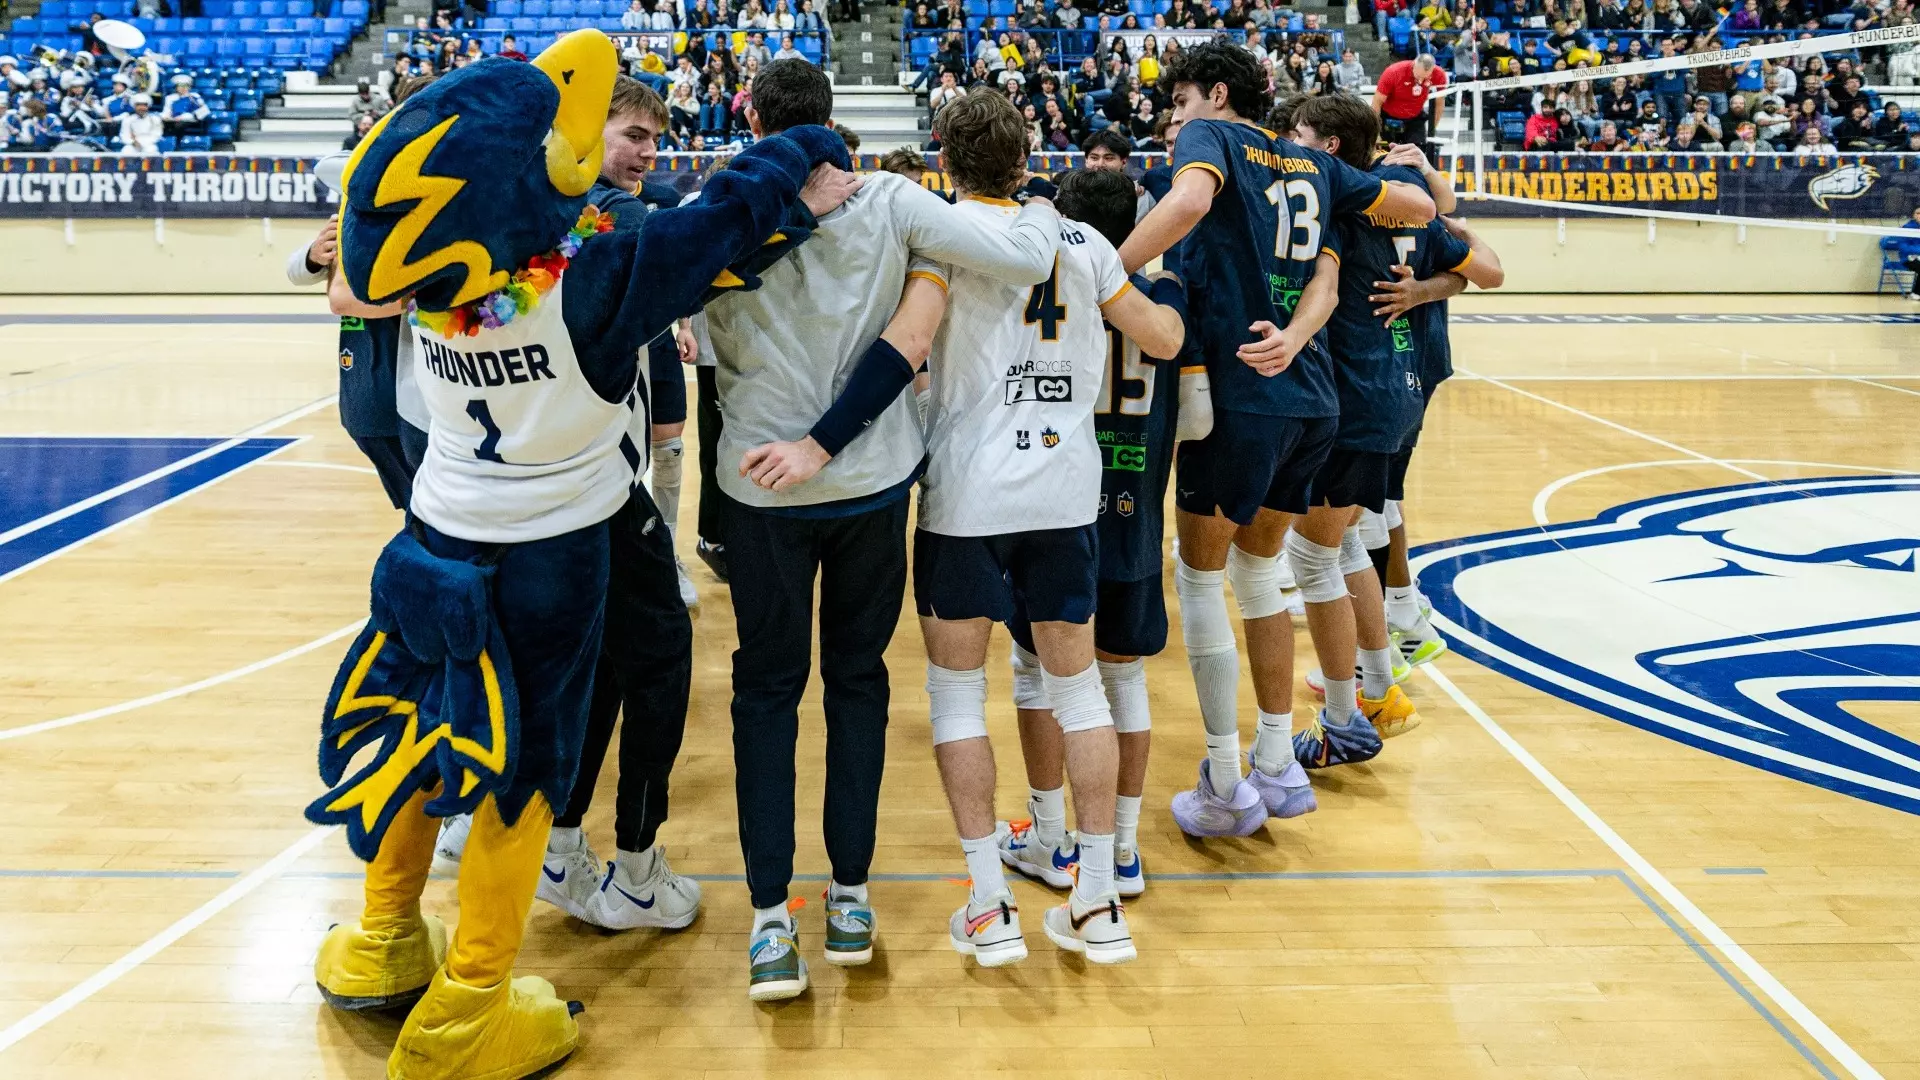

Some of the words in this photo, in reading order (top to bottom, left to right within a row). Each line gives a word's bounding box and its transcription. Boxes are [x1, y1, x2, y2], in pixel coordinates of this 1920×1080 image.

[146, 171, 317, 203] THROUGH
[1264, 179, 1321, 261] 13
[1024, 250, 1067, 342] 4
[419, 333, 557, 388] THUNDER
[465, 399, 508, 464] 1
